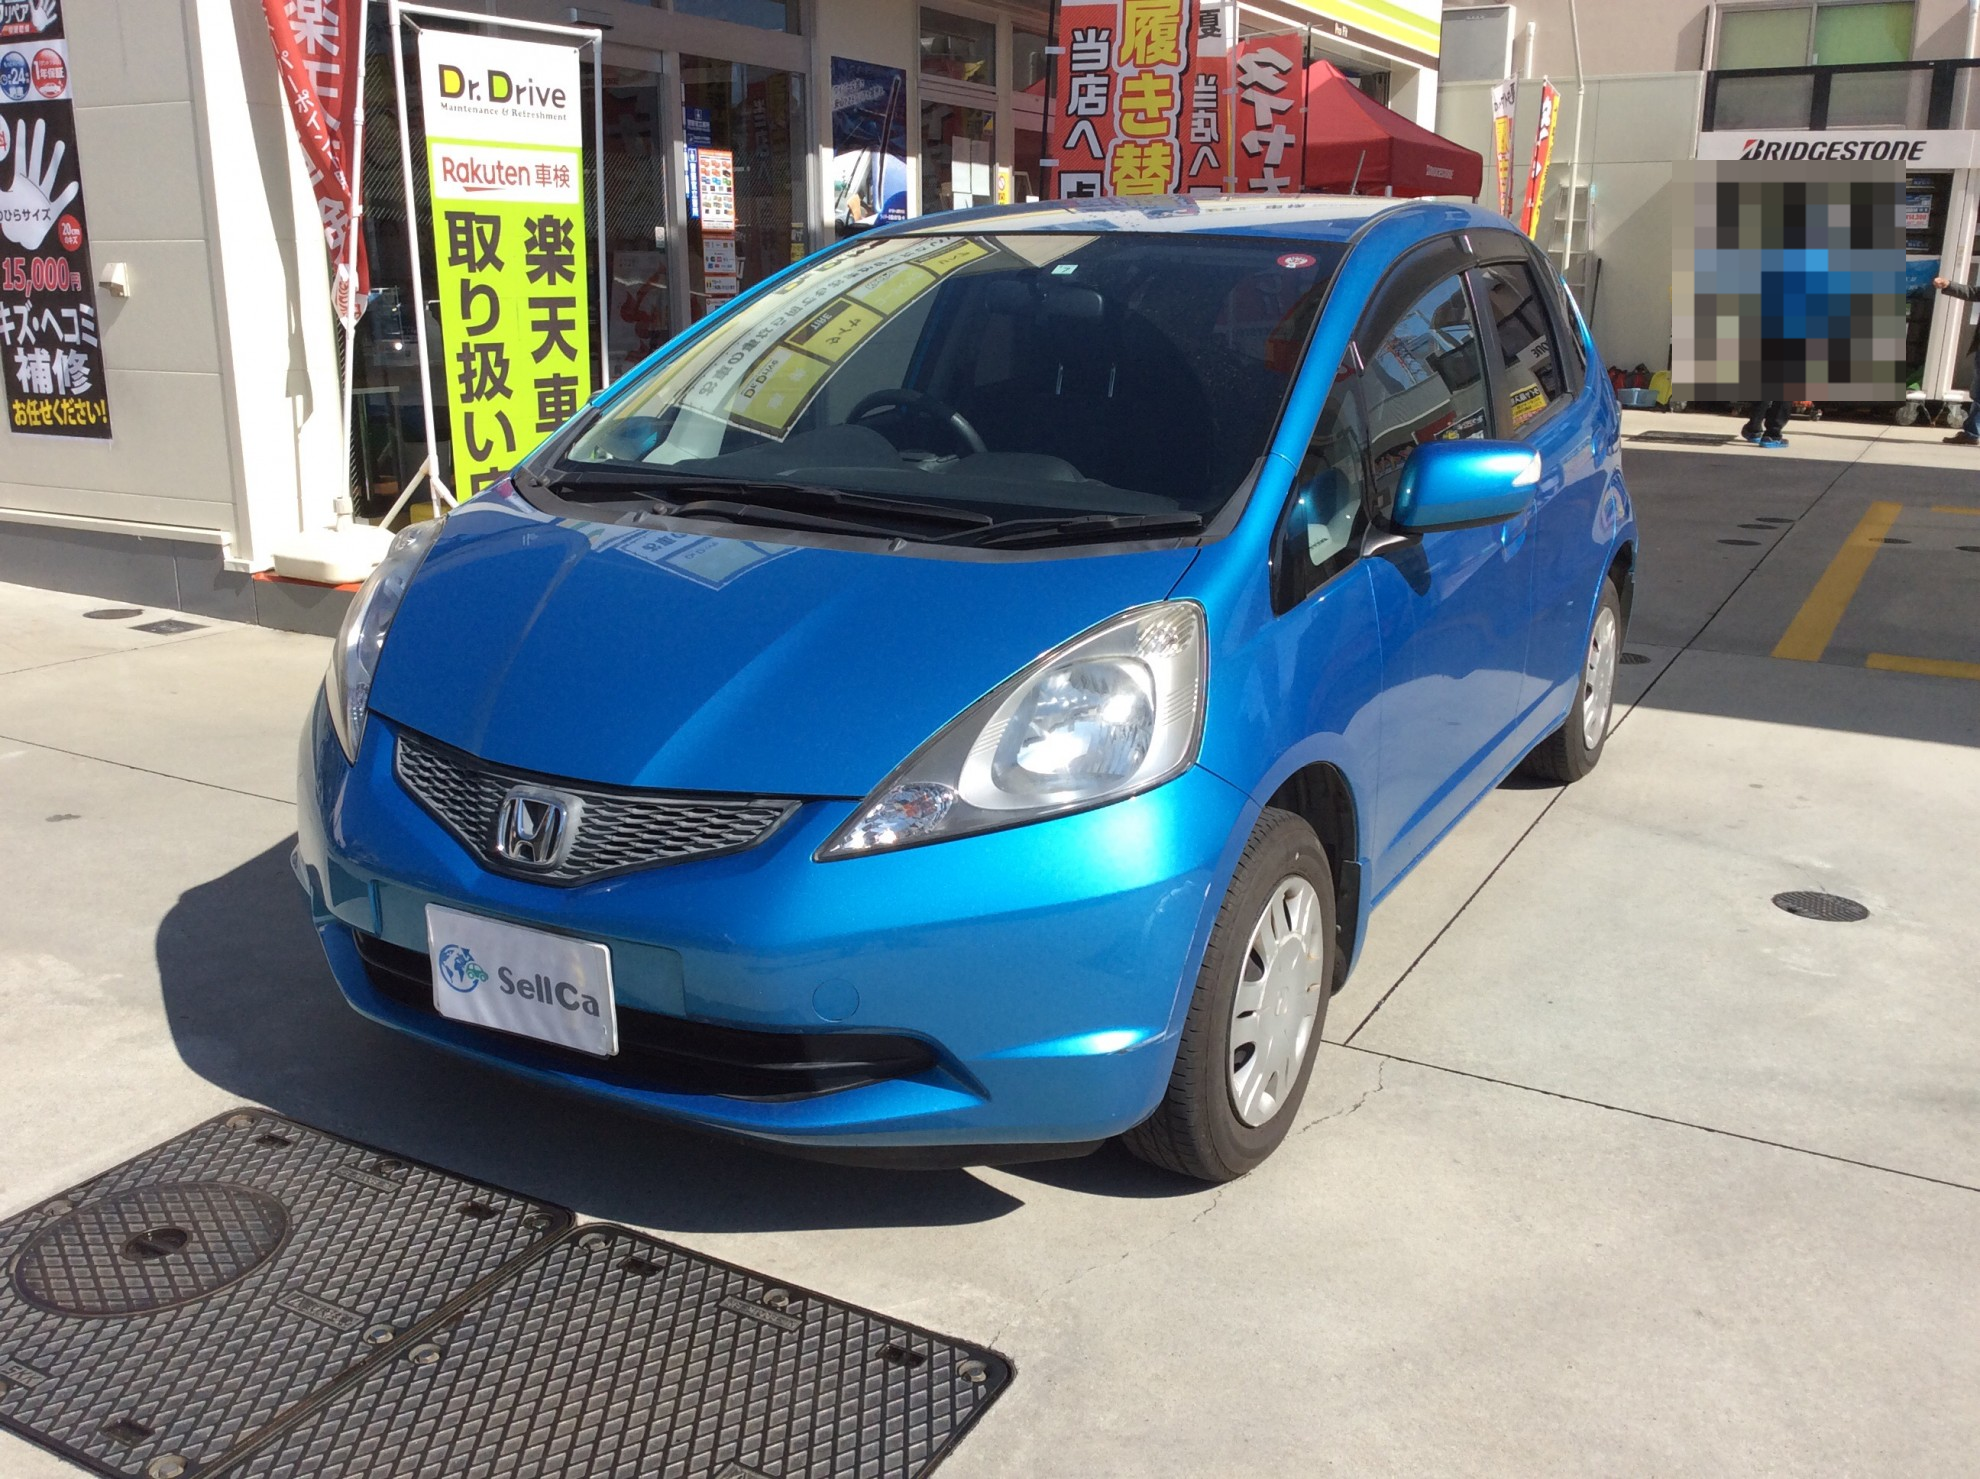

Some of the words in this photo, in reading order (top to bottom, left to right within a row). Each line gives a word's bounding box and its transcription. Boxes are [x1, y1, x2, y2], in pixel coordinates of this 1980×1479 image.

[440, 102, 499, 116] Maintenance
[511, 109, 567, 121] Refreshment
[1740, 139, 1927, 161] BRIDGESTONE
[442, 157, 531, 187] Rakuten
[535, 163, 570, 189] 車検
[14, 347, 93, 395] 補修
[12, 397, 108, 427] お任せください!
[498, 966, 600, 1017] SellCa
